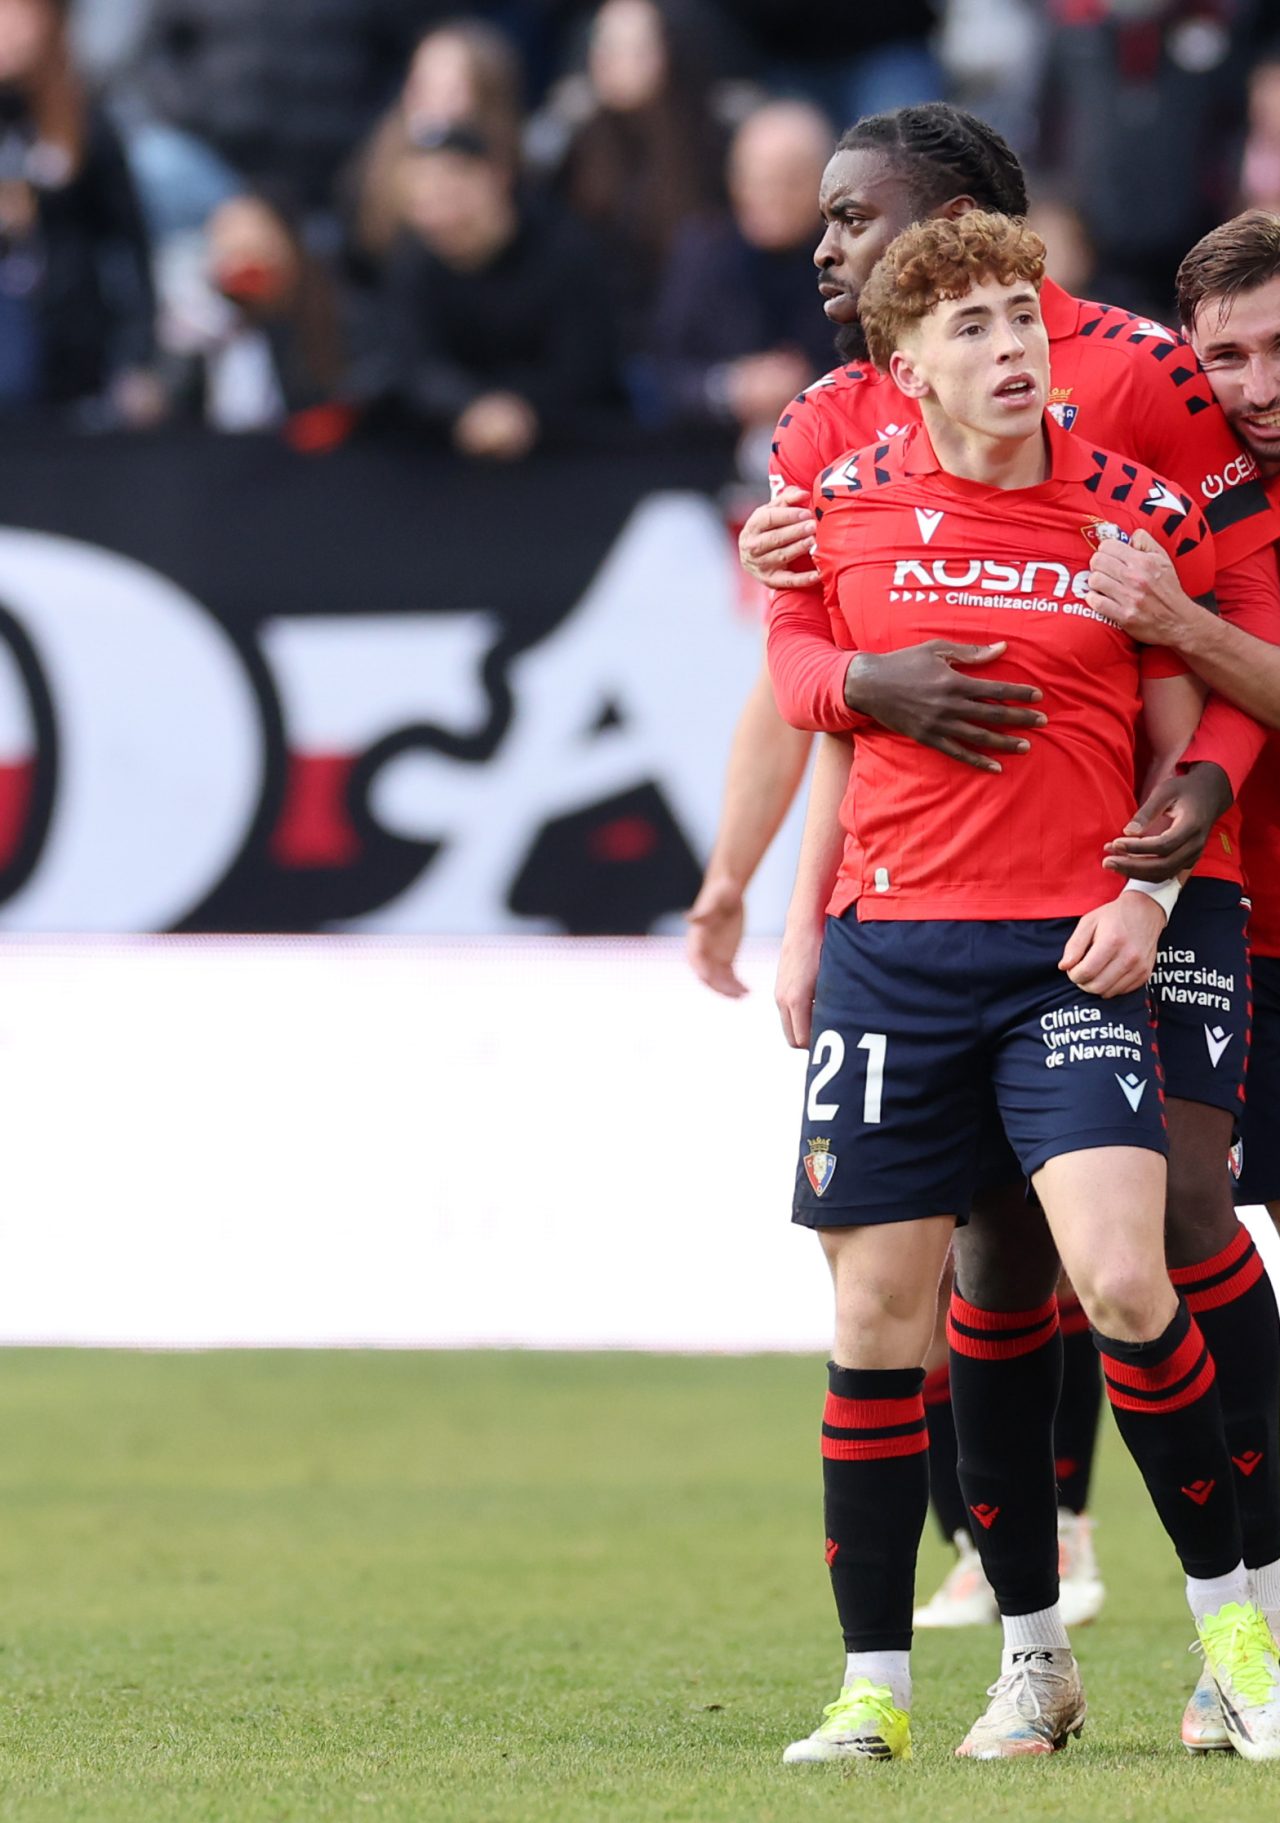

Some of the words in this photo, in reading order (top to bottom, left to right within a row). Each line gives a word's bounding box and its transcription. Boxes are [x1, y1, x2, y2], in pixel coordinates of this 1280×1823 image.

[945, 591, 1058, 613] Climatización
[1148, 967, 1234, 993] niversidad
[1161, 985, 1231, 1012] Navarra
[1040, 1005, 1102, 1032] Clínica
[1043, 1022, 1143, 1050] Universidad
[1045, 1051, 1065, 1069] de
[1069, 1043, 1142, 1063] Navarra
[807, 1029, 888, 1124] 21
